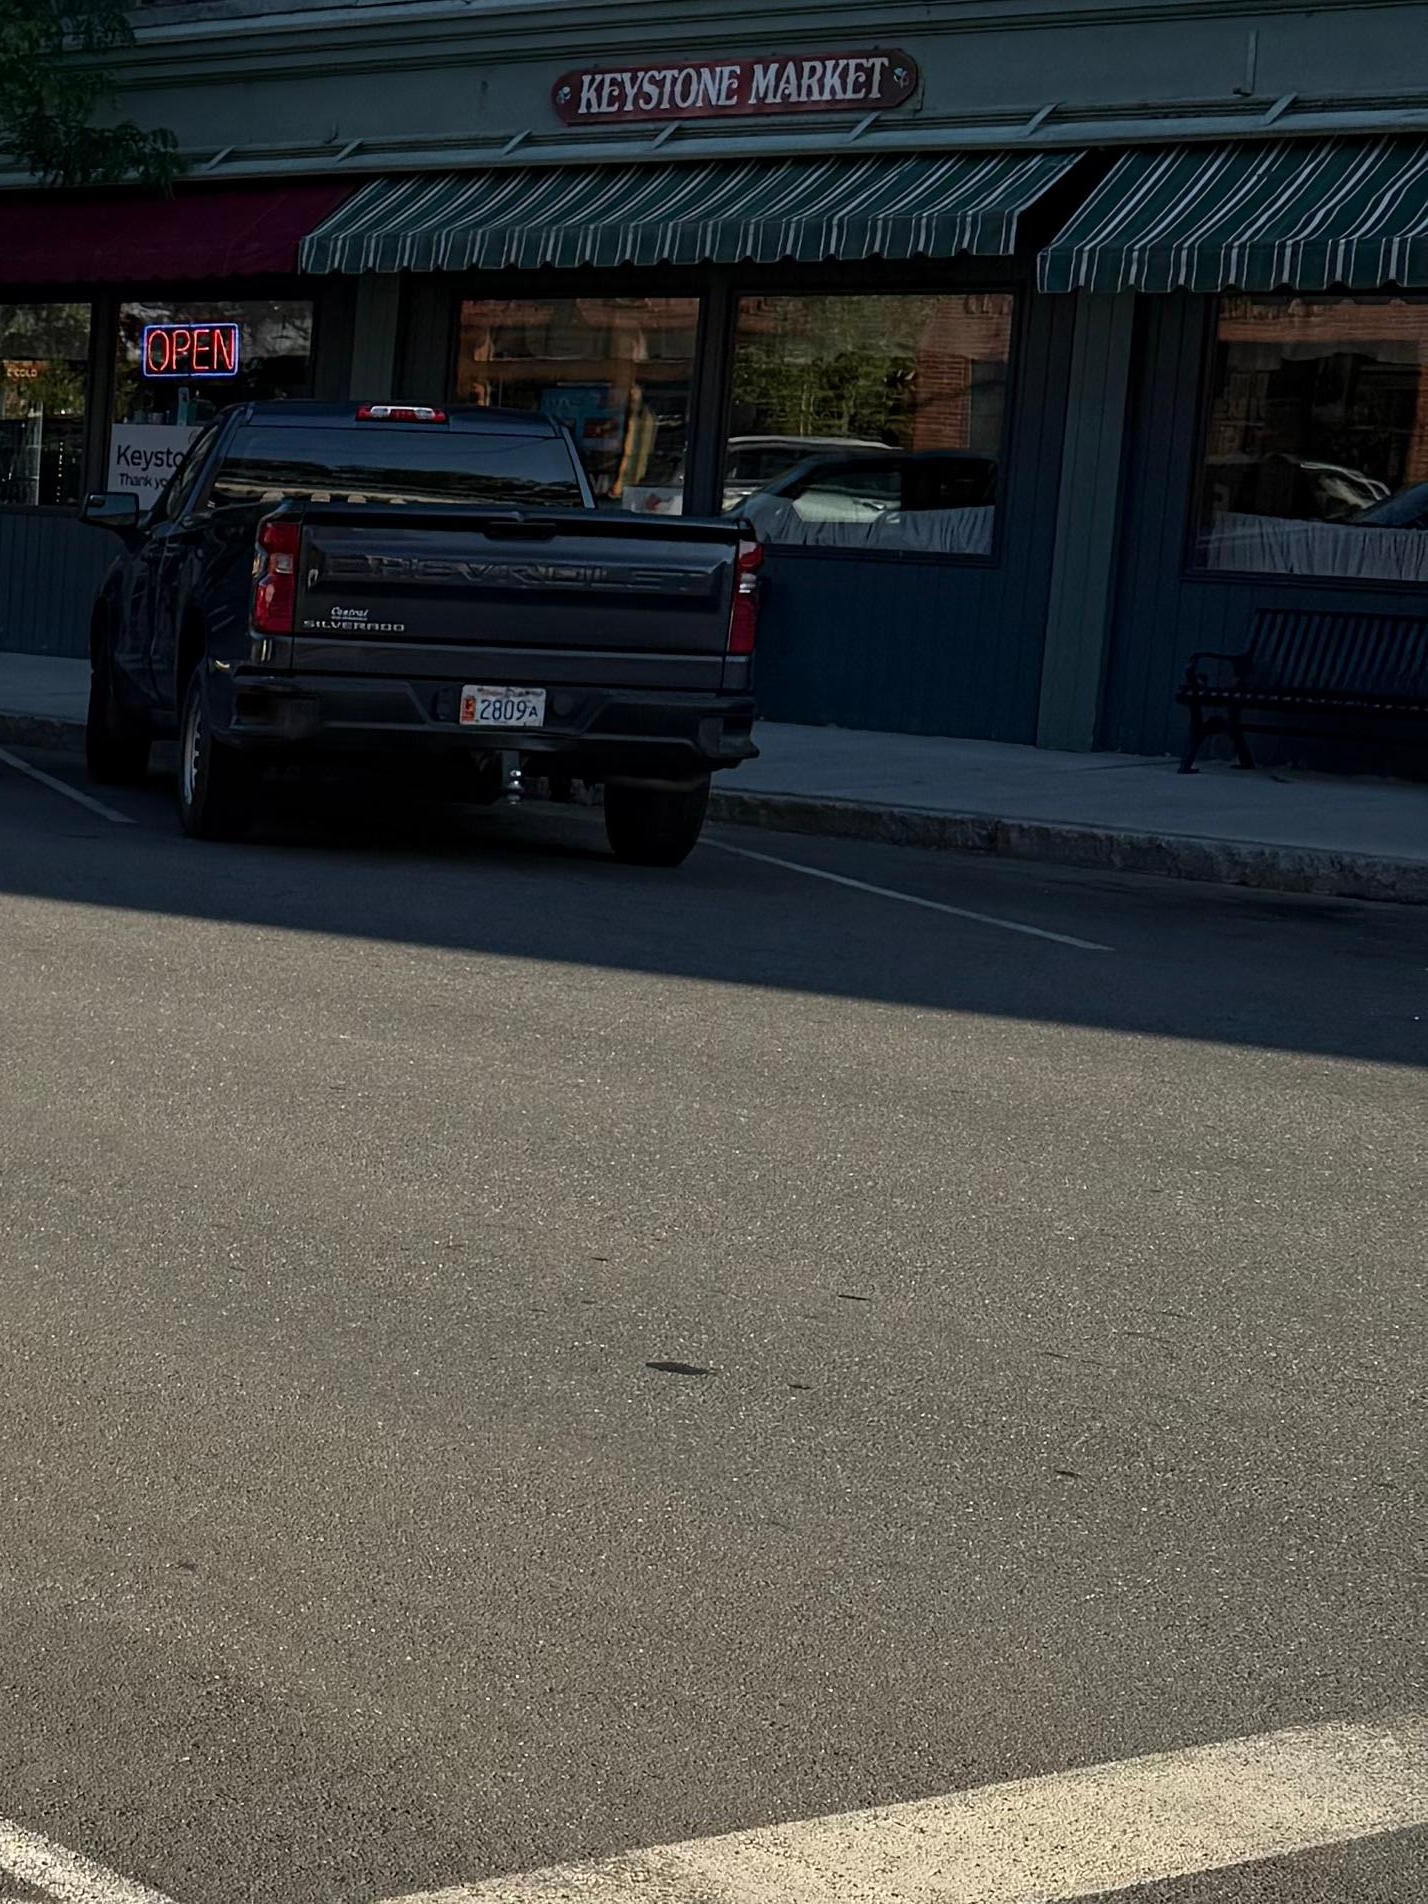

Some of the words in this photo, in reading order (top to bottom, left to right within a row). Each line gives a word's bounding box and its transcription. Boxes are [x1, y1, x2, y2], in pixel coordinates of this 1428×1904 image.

[578, 65, 741, 114] KEYSTONE
[748, 57, 889, 105] MARKET
[148, 329, 235, 371] OPEN
[120, 472, 151, 486] Thank
[304, 620, 405, 632] SILVERADO
